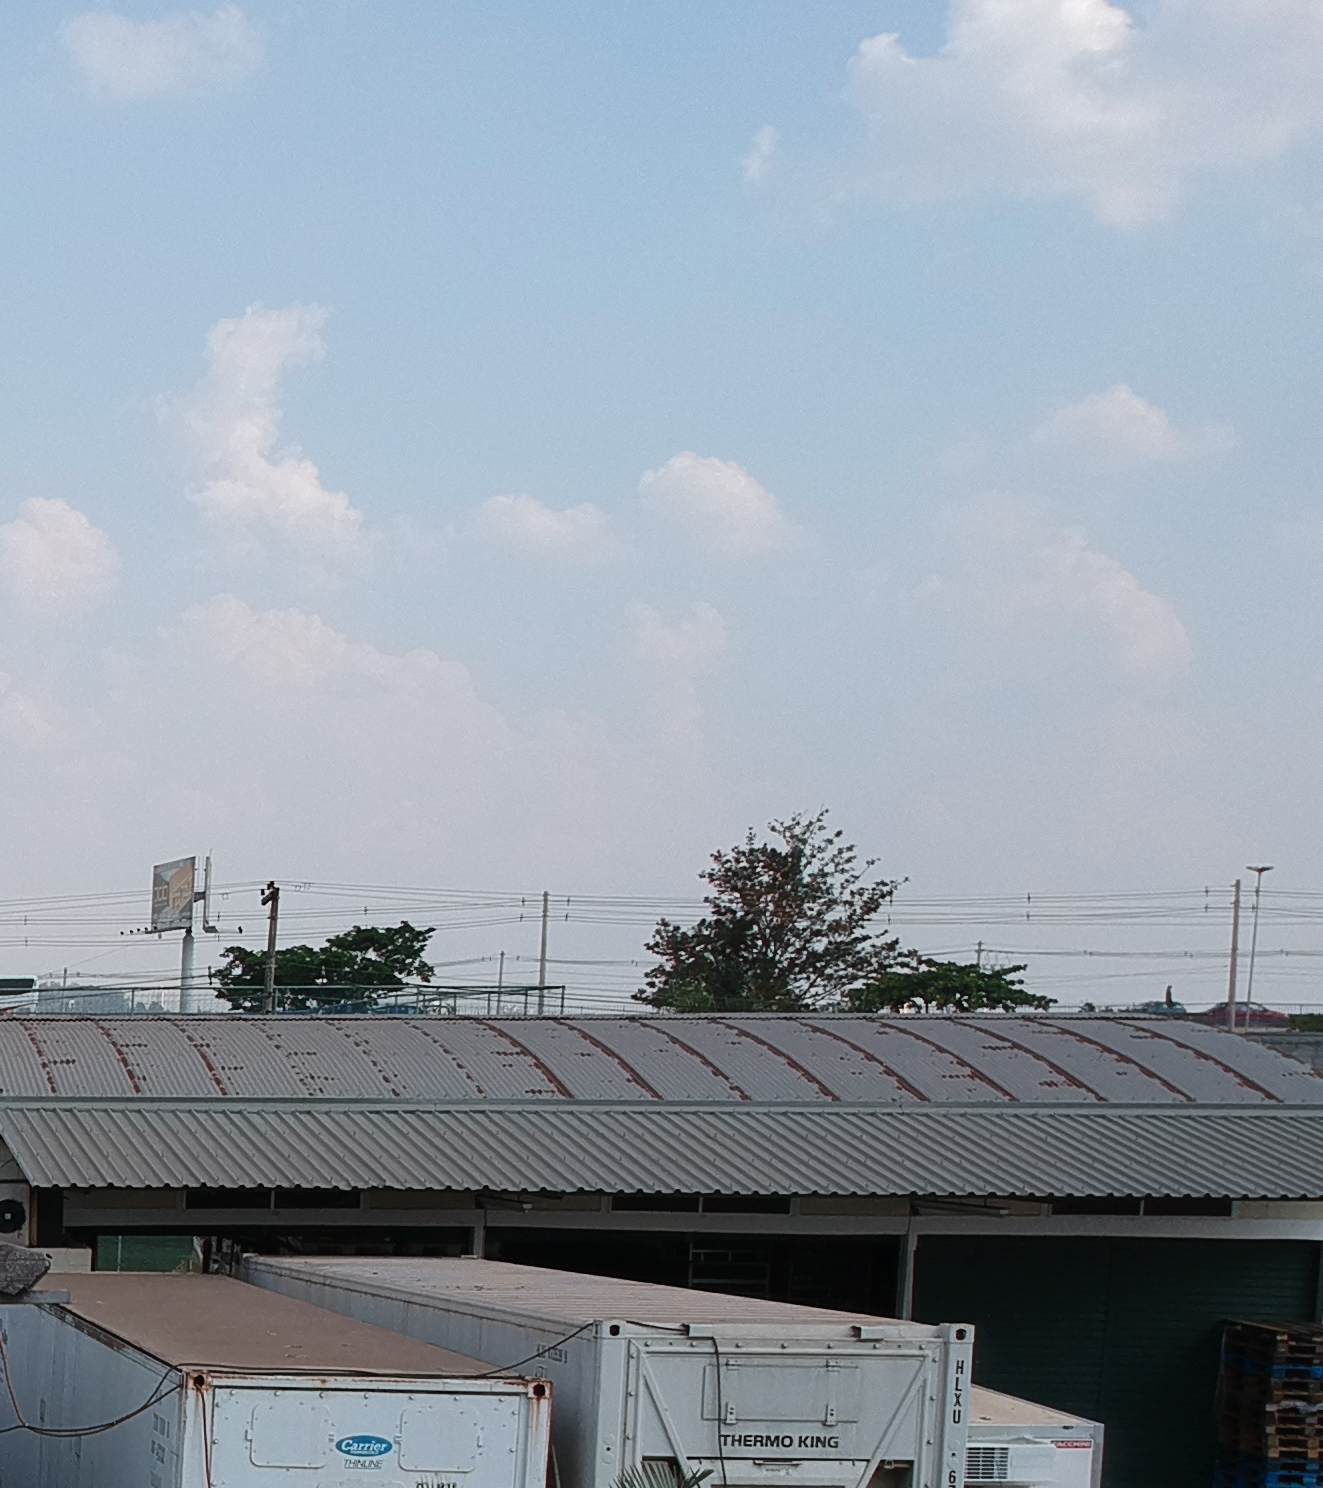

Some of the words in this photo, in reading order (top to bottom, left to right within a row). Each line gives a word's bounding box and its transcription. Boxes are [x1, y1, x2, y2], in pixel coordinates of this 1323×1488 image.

[952, 1359, 965, 1424] HLXU
[341, 1439, 388, 1451] Carrier
[719, 1434, 793, 1448] THERMO
[798, 1436, 839, 1449] KING
